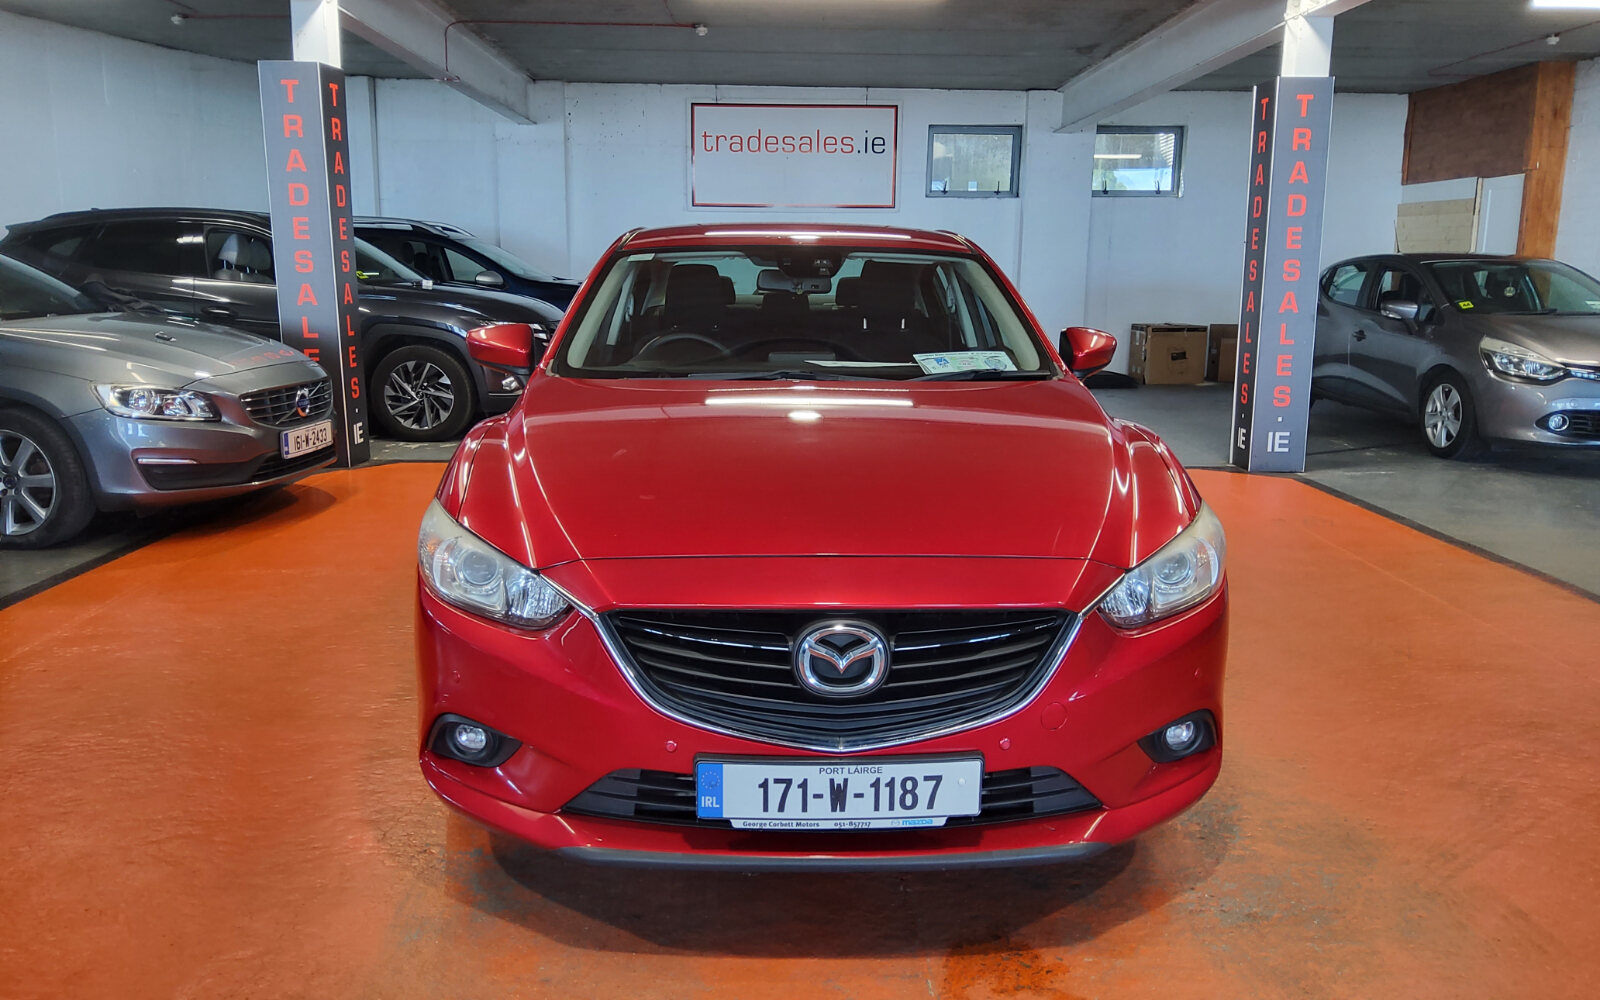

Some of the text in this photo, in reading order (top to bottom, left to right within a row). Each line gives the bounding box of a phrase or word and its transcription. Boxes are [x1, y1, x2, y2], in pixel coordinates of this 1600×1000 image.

[701, 128, 886, 154] tradesales.ie
[294, 428, 327, 451] 161-W-2433
[819, 766, 883, 775] PORT LÁIRGE
[701, 796, 720, 808] IRL
[758, 775, 943, 813] 171-W-1187
[742, 821, 767, 829] George
